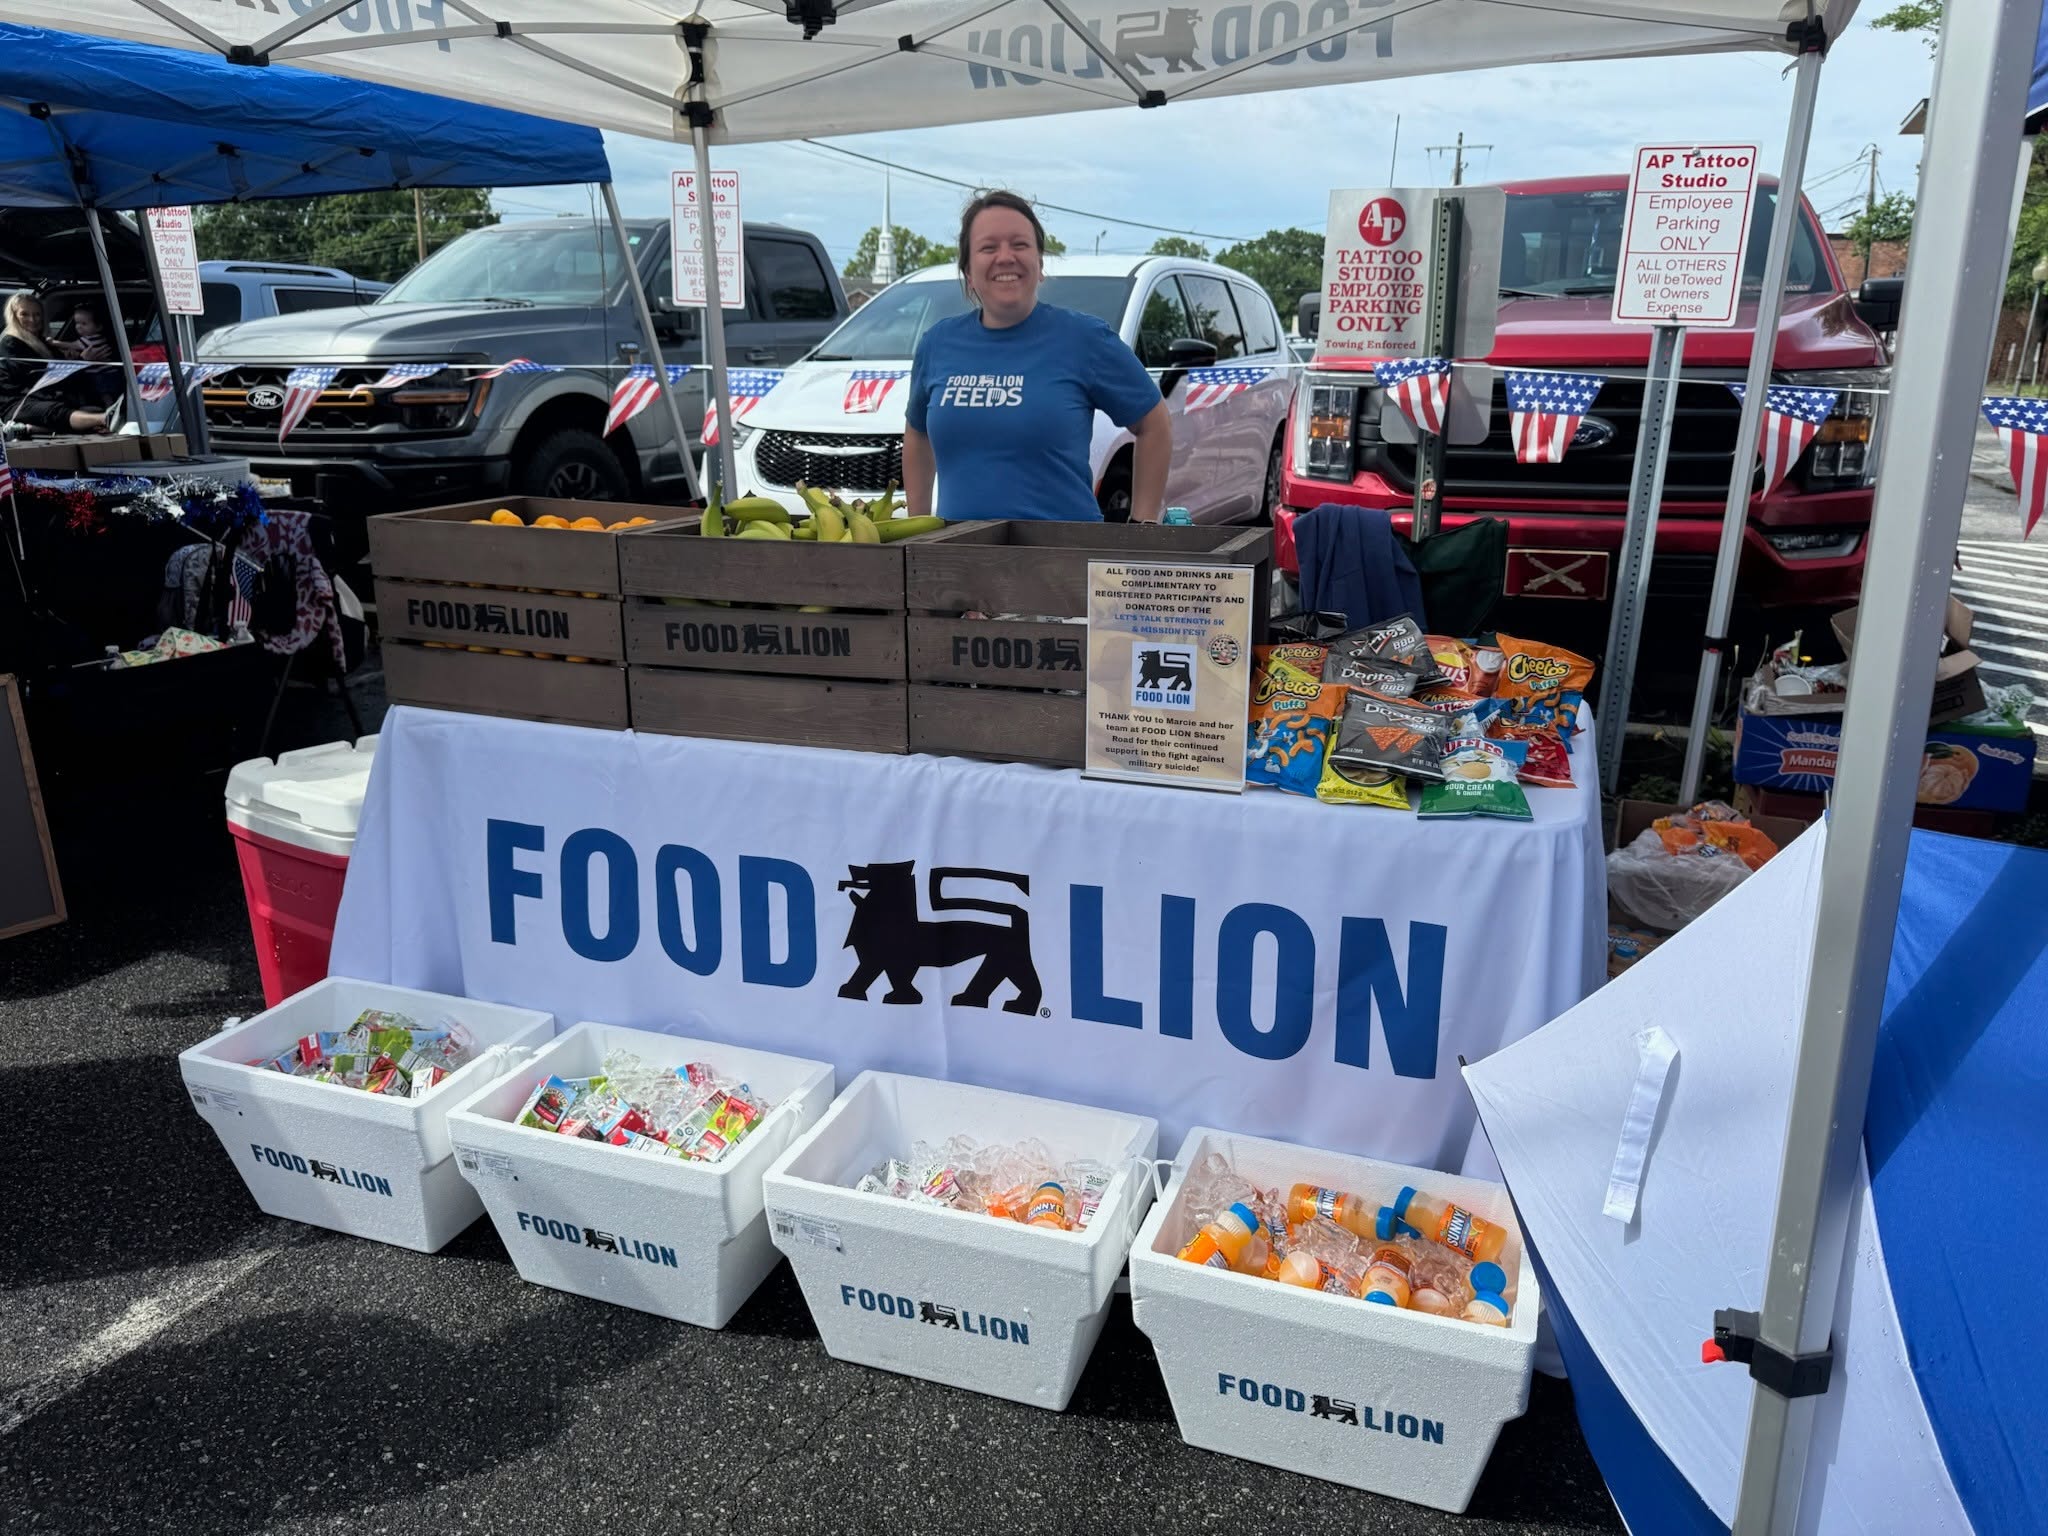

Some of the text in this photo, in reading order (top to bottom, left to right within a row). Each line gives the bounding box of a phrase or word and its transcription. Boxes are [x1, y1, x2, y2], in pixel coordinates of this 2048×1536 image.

[1646, 154, 1749, 169] AP Tattoo
[677, 177, 693, 188] AP
[1661, 173, 1728, 188] Studio
[1649, 194, 1734, 213] Employee
[683, 207, 732, 220] Emyee
[689, 222, 726, 237] Pang
[1362, 202, 1403, 242] AP
[1655, 215, 1721, 234] Parking
[160, 245, 186, 257] Parking
[1660, 236, 1711, 251] ONLY
[163, 258, 184, 267] ONLY
[682, 256, 734, 266] ALL OERS
[1336, 249, 1423, 265] TATTOO
[1636, 259, 1727, 271] ALL OTHERS
[1338, 266, 1415, 282] STUDIO
[1638, 273, 1660, 285] Will
[1328, 283, 1424, 298] EMPLOYEE
[1643, 287, 1710, 299] at Owners
[1328, 299, 1422, 315] PARKING
[1647, 302, 1703, 315] Expense
[1336, 316, 1410, 333] ONLY
[1325, 339, 1416, 351] Towing Enforced
[946, 375, 1024, 387] FOOD LION
[939, 387, 1023, 407] FEEDS
[1126, 568, 1151, 576] FOOD
[1154, 569, 1173, 577] AND
[1176, 571, 1212, 579] DRINKS
[1214, 572, 1234, 580] ARE
[1122, 580, 1217, 591] COMPLIMENTARY TO
[1095, 590, 1152, 600] REGISTERED
[1154, 593, 1222, 604] PARTICIPANTS
[1125, 603, 1175, 613] DONATORS
[407, 598, 570, 640] FOOD LION
[1114, 613, 1138, 621] LET'S
[1164, 616, 1211, 626] STRENGTH
[1213, 618, 1225, 626] 5K
[1140, 626, 1180, 635] MISSION
[1183, 628, 1206, 637] FEST
[665, 622, 851, 657] FOOD LION
[952, 636, 1033, 669] FOOD
[1509, 655, 1570, 682] Cheetos
[1255, 677, 1320, 702] Cheetos
[1135, 690, 1190, 705] FOOD LION
[1273, 700, 1306, 711] Puffs
[1099, 712, 1234, 730] THANK YOU to Marcie and her
[1106, 724, 1225, 741] team at FOOD LION Shears
[1112, 735, 1218, 751] Road for their continued
[1105, 746, 1225, 763] support in the fight against
[1128, 758, 1162, 770] military
[1466, 783, 1494, 791] CREAM
[487, 818, 1449, 1080] FOOD LION
[251, 1143, 392, 1198] FOOD LION
[516, 1210, 678, 1268] FOOD LION
[841, 1284, 1030, 1346] FOOD LION
[1217, 1372, 1445, 1446] FOOD LION
